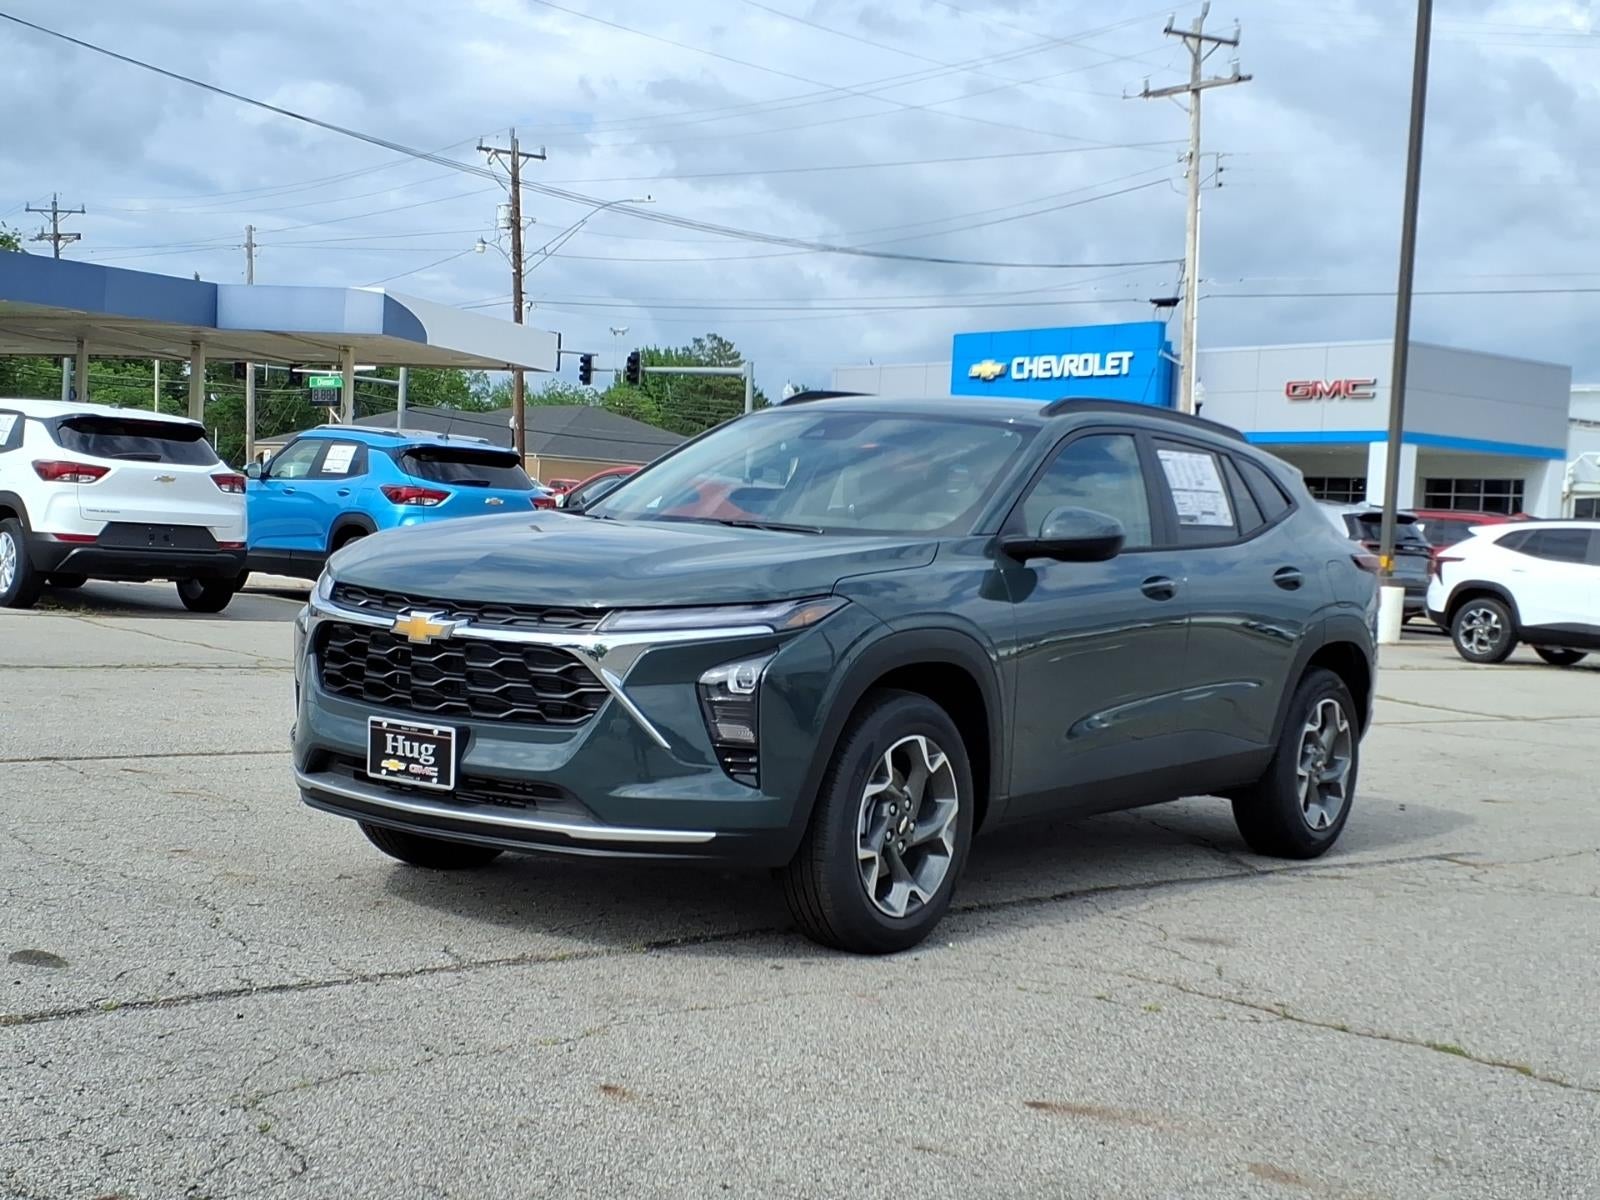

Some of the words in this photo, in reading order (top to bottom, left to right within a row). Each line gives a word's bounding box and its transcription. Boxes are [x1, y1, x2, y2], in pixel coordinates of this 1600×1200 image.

[1011, 351, 1134, 379] CHEVROLET
[1285, 377, 1377, 400] GMC
[384, 733, 436, 765] Hug
[409, 763, 439, 776] GMC
